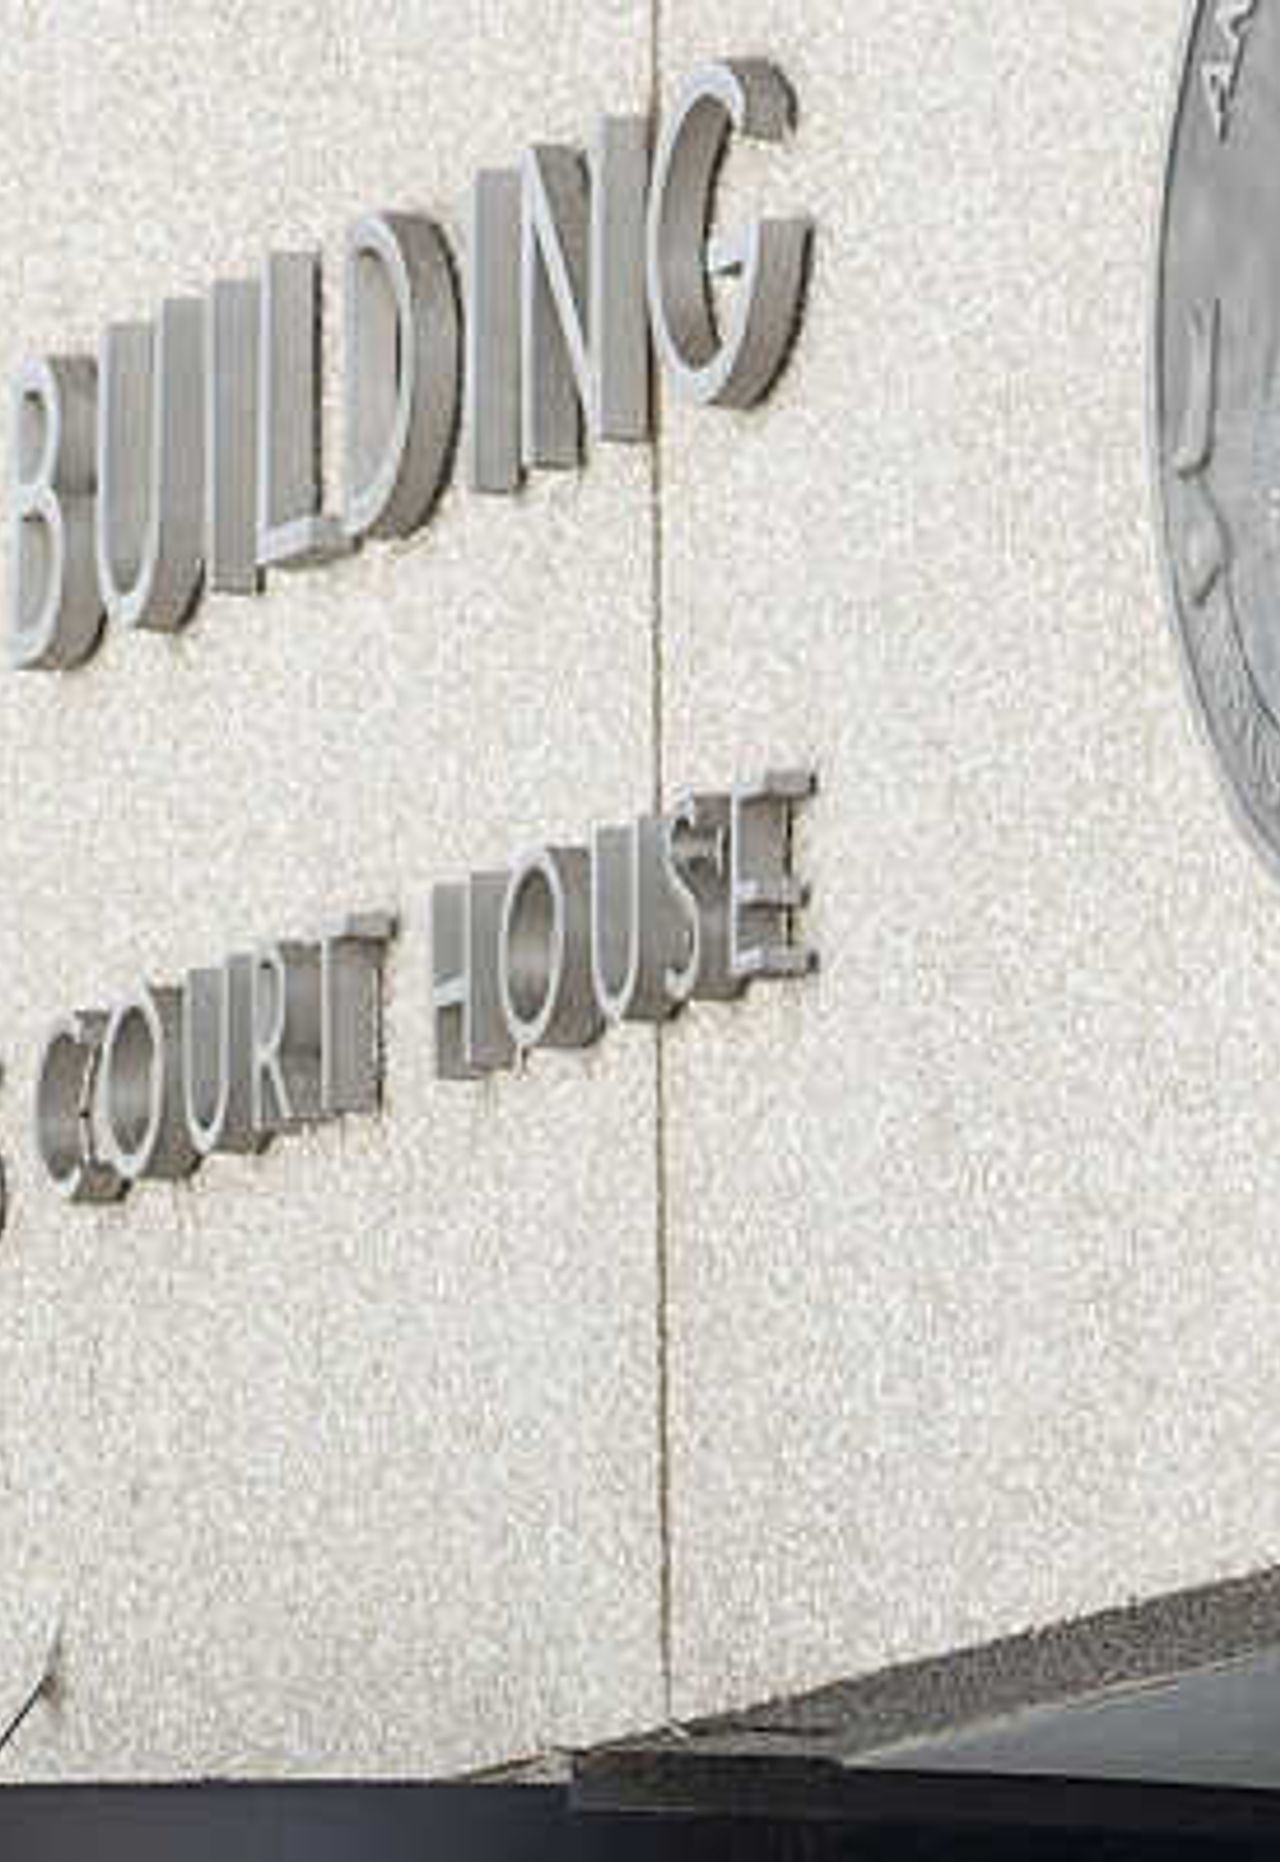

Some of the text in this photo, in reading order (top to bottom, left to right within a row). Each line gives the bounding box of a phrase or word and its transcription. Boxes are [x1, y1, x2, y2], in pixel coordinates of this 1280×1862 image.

[10, 57, 816, 672] BUILDING
[34, 912, 399, 1205] COURT
[432, 770, 820, 1081] HOUSE
